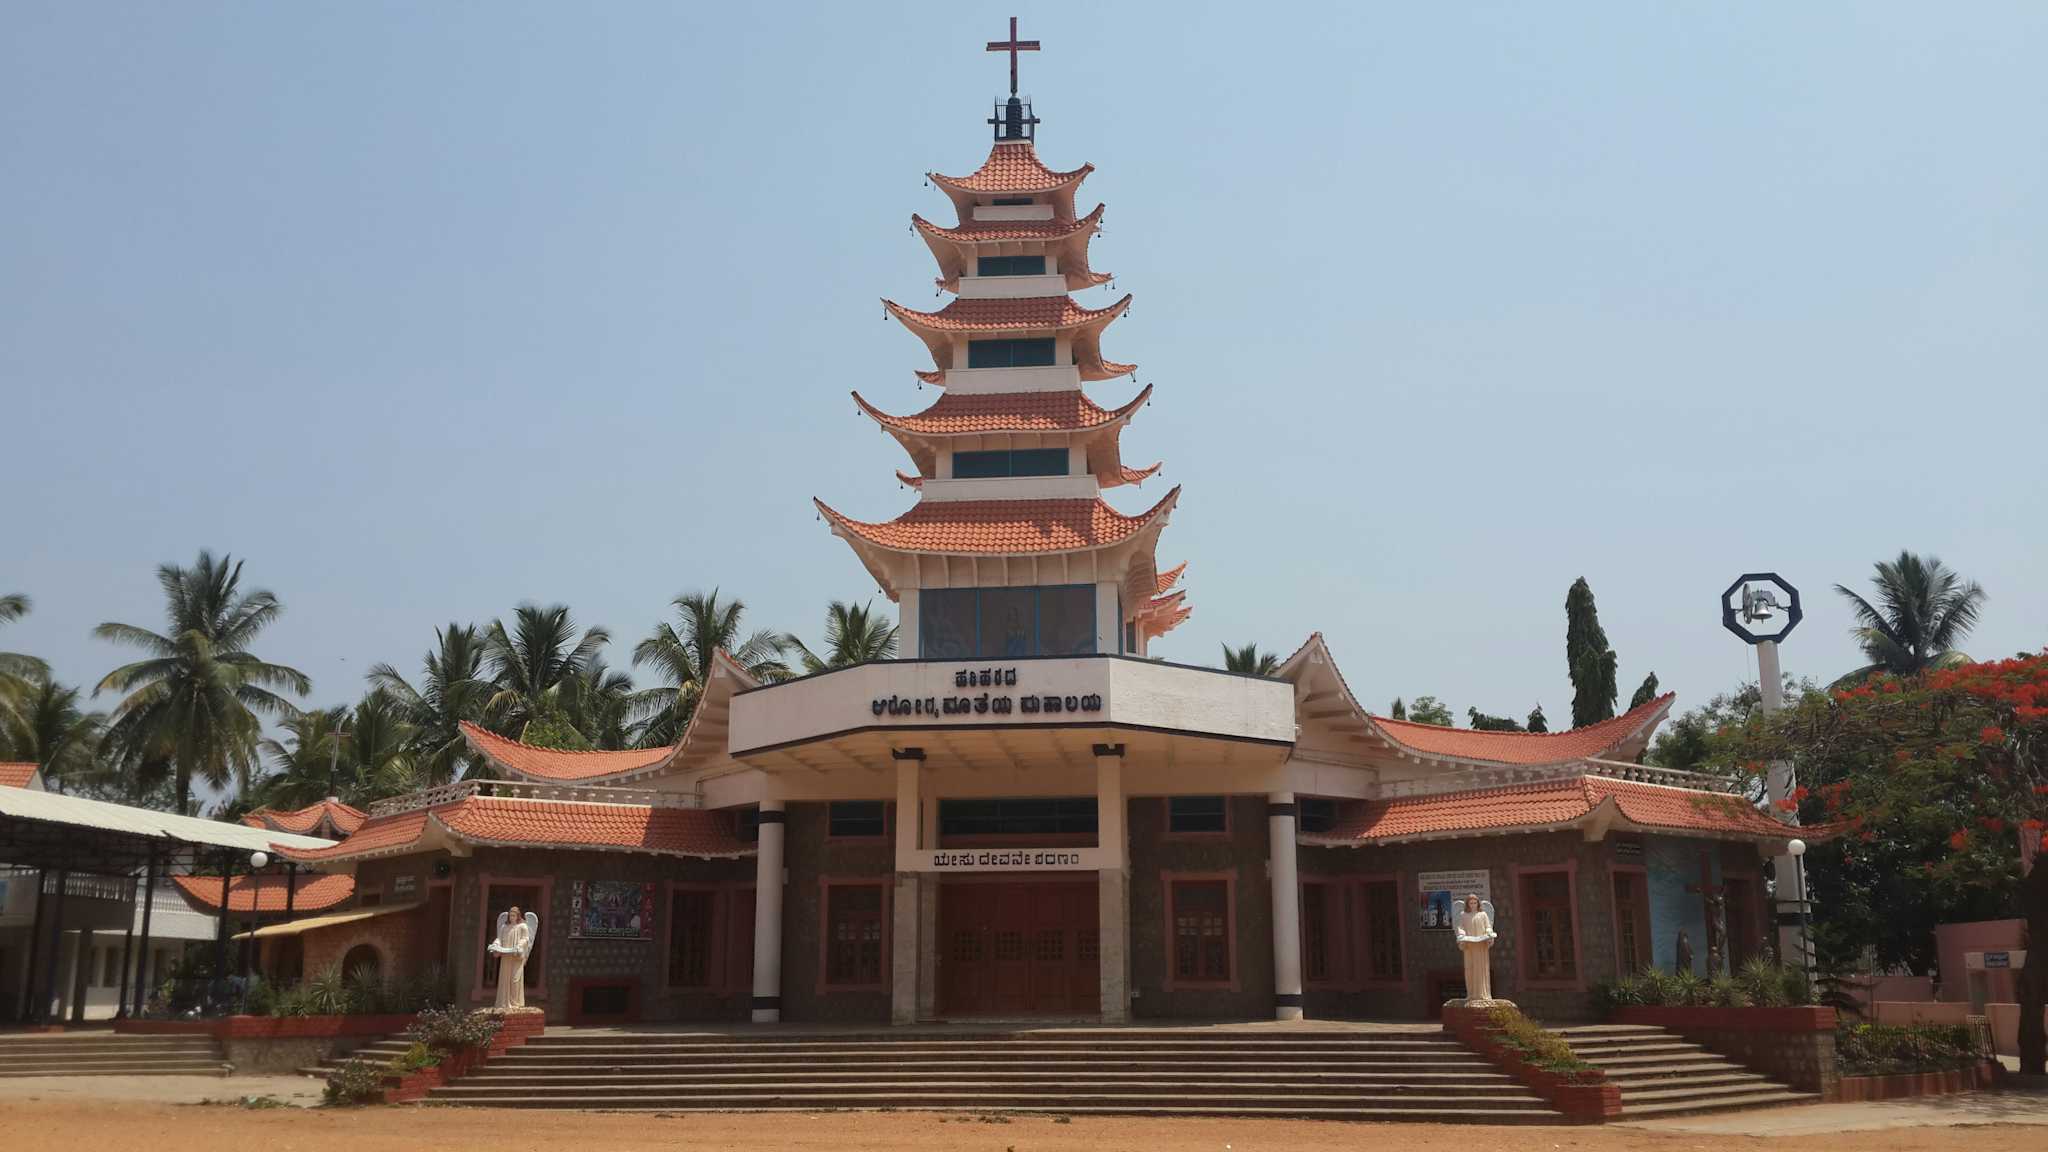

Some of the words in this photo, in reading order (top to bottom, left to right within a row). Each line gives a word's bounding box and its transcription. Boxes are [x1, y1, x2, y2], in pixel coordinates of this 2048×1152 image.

[955, 667, 1017, 687] ಹರಿಹರದ
[872, 695, 939, 719] ಆರೋಗ್ಯ
[943, 693, 1012, 715] ಮಾತೆಯ
